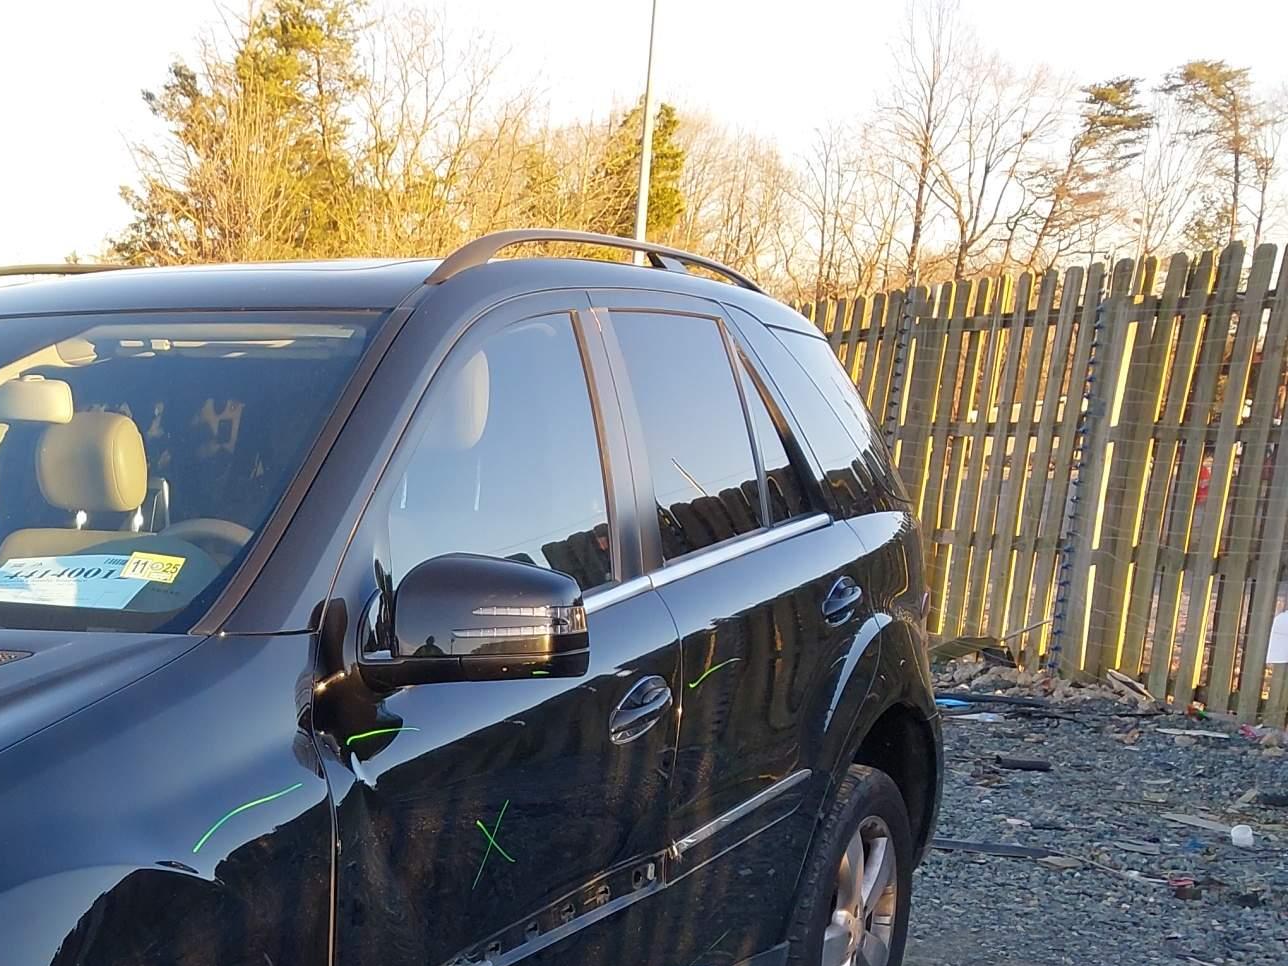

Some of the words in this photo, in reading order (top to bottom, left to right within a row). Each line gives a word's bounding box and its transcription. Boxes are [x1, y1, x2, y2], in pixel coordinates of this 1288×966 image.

[5, 567, 128, 579] 4414001
[132, 559, 148, 574] 11
[162, 562, 180, 574] 25
